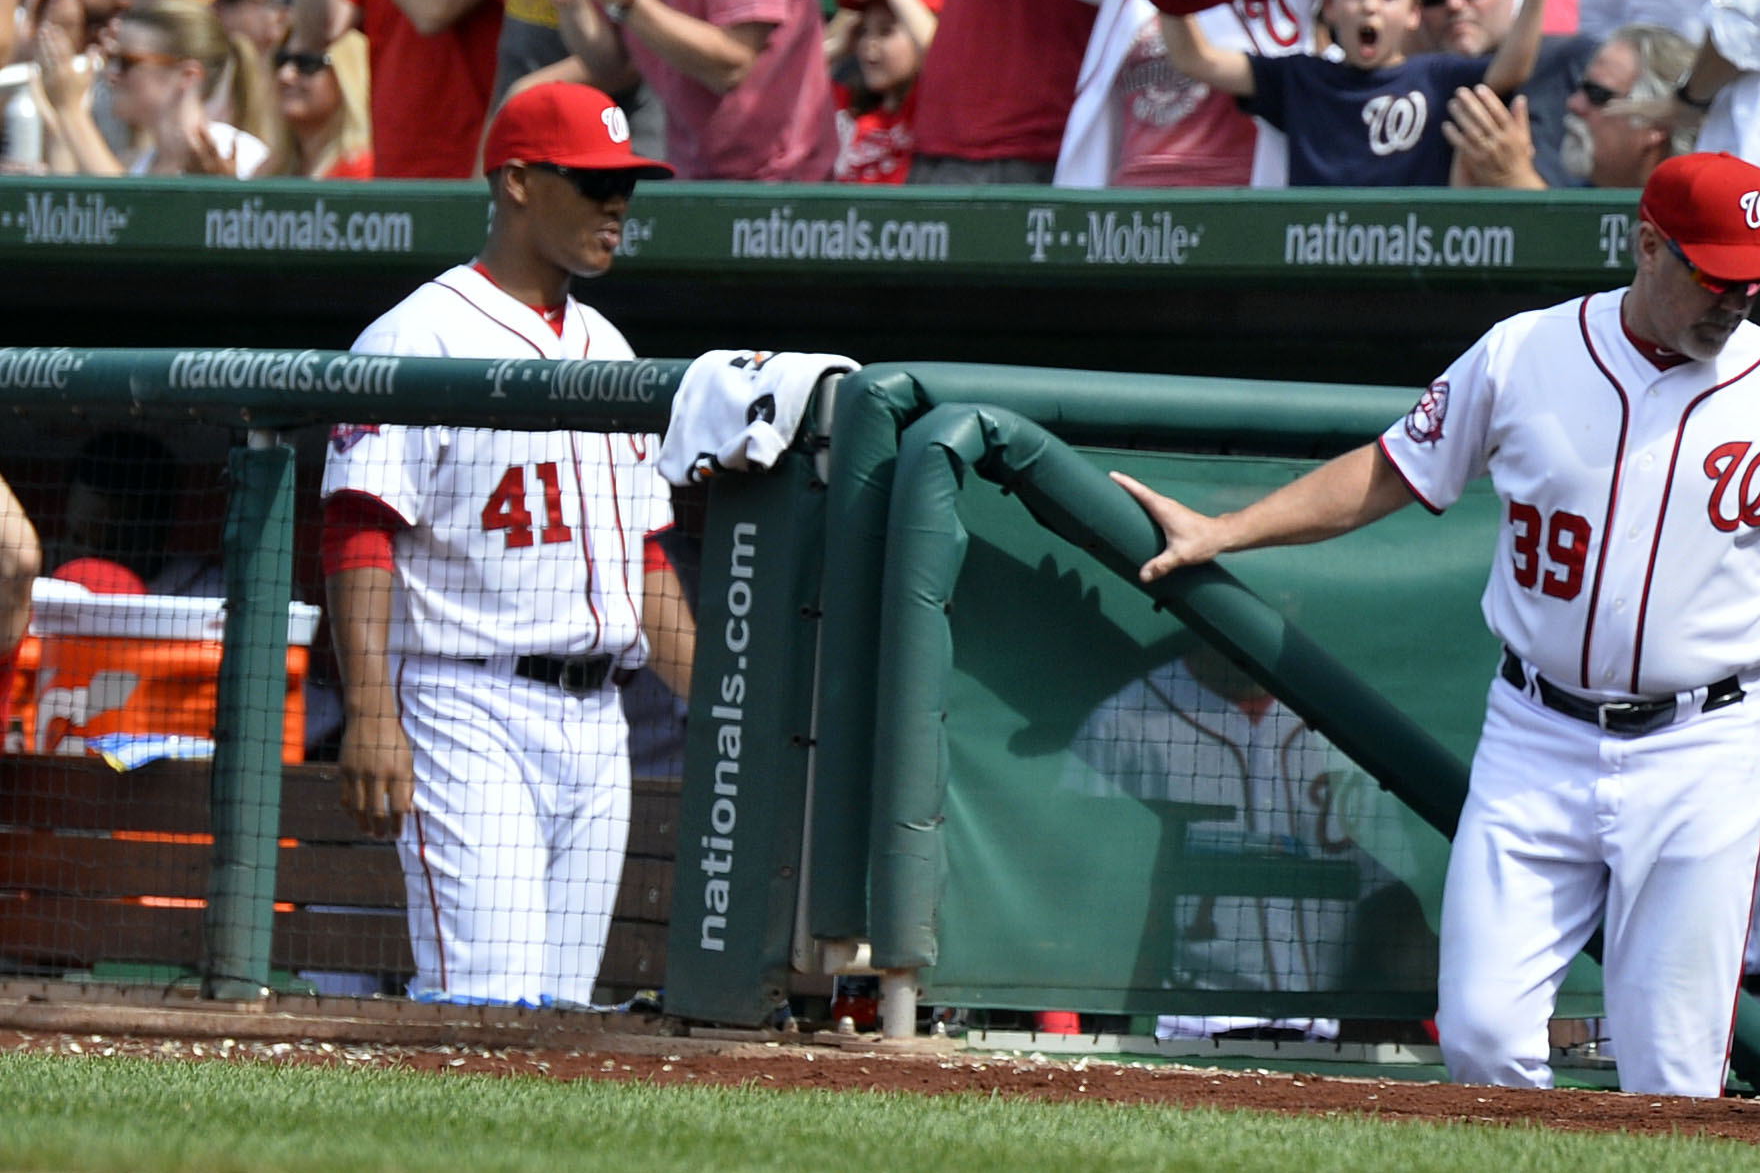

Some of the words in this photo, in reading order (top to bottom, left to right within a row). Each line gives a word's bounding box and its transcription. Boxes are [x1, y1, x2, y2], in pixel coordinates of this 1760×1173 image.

[204, 197, 413, 252] nationals.com
[732, 206, 949, 262] nationals.com
[1285, 211, 1515, 268] nationals.com
[168, 348, 401, 396] nationals.com
[481, 462, 572, 548] 41
[1509, 499, 1592, 602] 39
[700, 522, 758, 952] nationals.com
